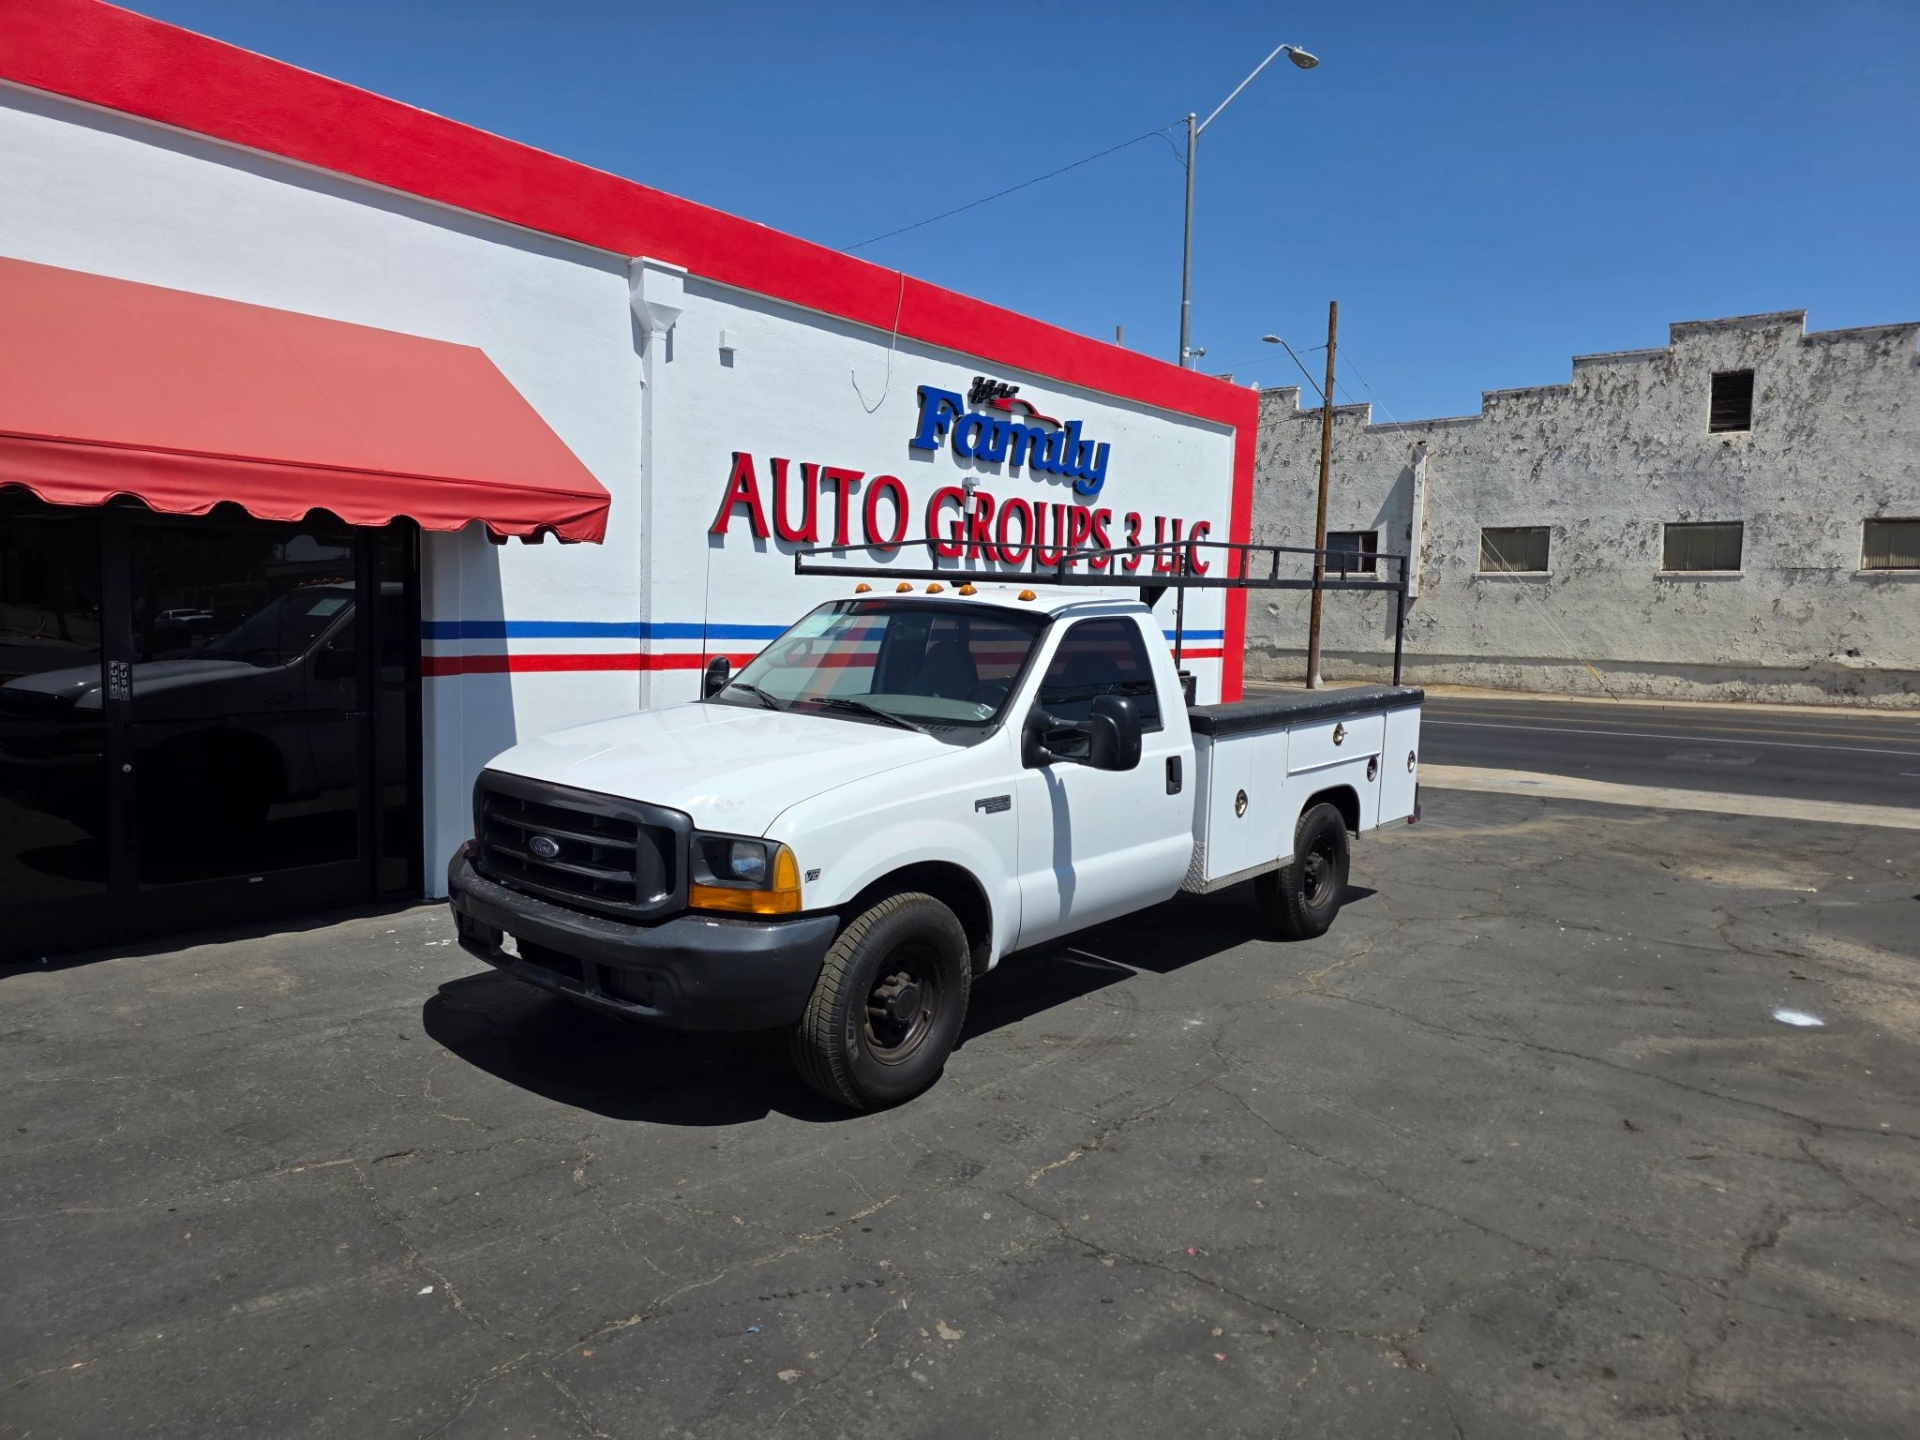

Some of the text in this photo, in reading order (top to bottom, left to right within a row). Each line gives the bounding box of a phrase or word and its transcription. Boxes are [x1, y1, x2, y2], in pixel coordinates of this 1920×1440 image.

[909, 385, 1111, 496] Family
[708, 451, 910, 552] AUTO
[925, 486, 1112, 570] GROUPS
[1122, 511, 1142, 571] 3
[110, 662, 118, 691] PUSH
[120, 664, 128, 693] PUSH
